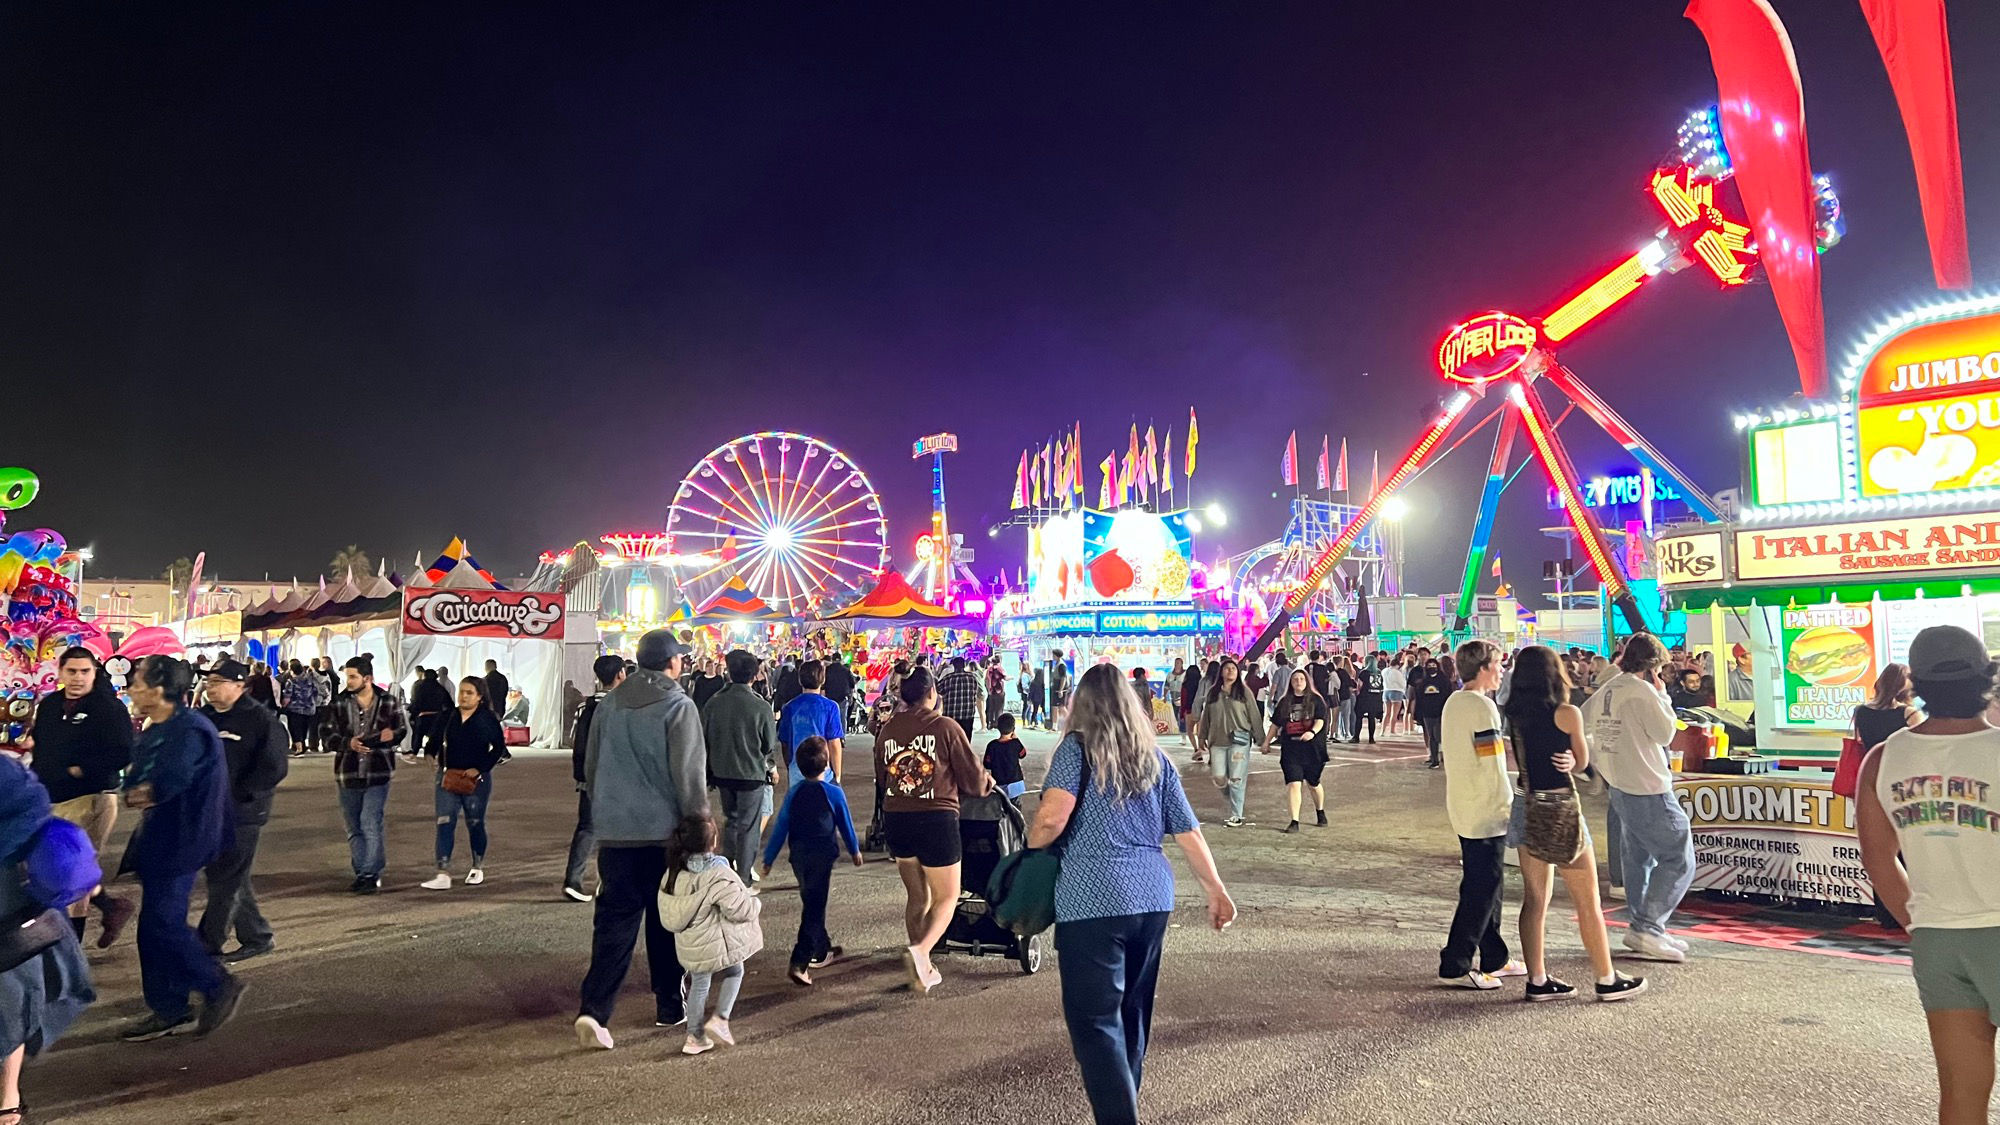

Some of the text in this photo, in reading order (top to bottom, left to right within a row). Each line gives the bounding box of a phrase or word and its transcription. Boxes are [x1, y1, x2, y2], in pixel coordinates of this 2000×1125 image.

[1445, 322, 1537, 379] HYPER LOOP
[1889, 352, 2000, 392] JUMBO
[1752, 528, 1910, 560] ITALIAN
[1839, 552, 1930, 570] SAUSAGE
[1103, 615, 1146, 628] COTTON
[1157, 614, 1195, 628] CANDY
[1798, 687, 1865, 704] ITALIAN
[1675, 785, 1830, 825] GOURMET
[1726, 836, 1764, 850] RANCH
[1767, 841, 1800, 855] FRIES
[1734, 856, 1765, 869] FRIES
[1796, 862, 1826, 876] CHILI
[1737, 874, 1861, 898] BACON CHEESE FRIES
